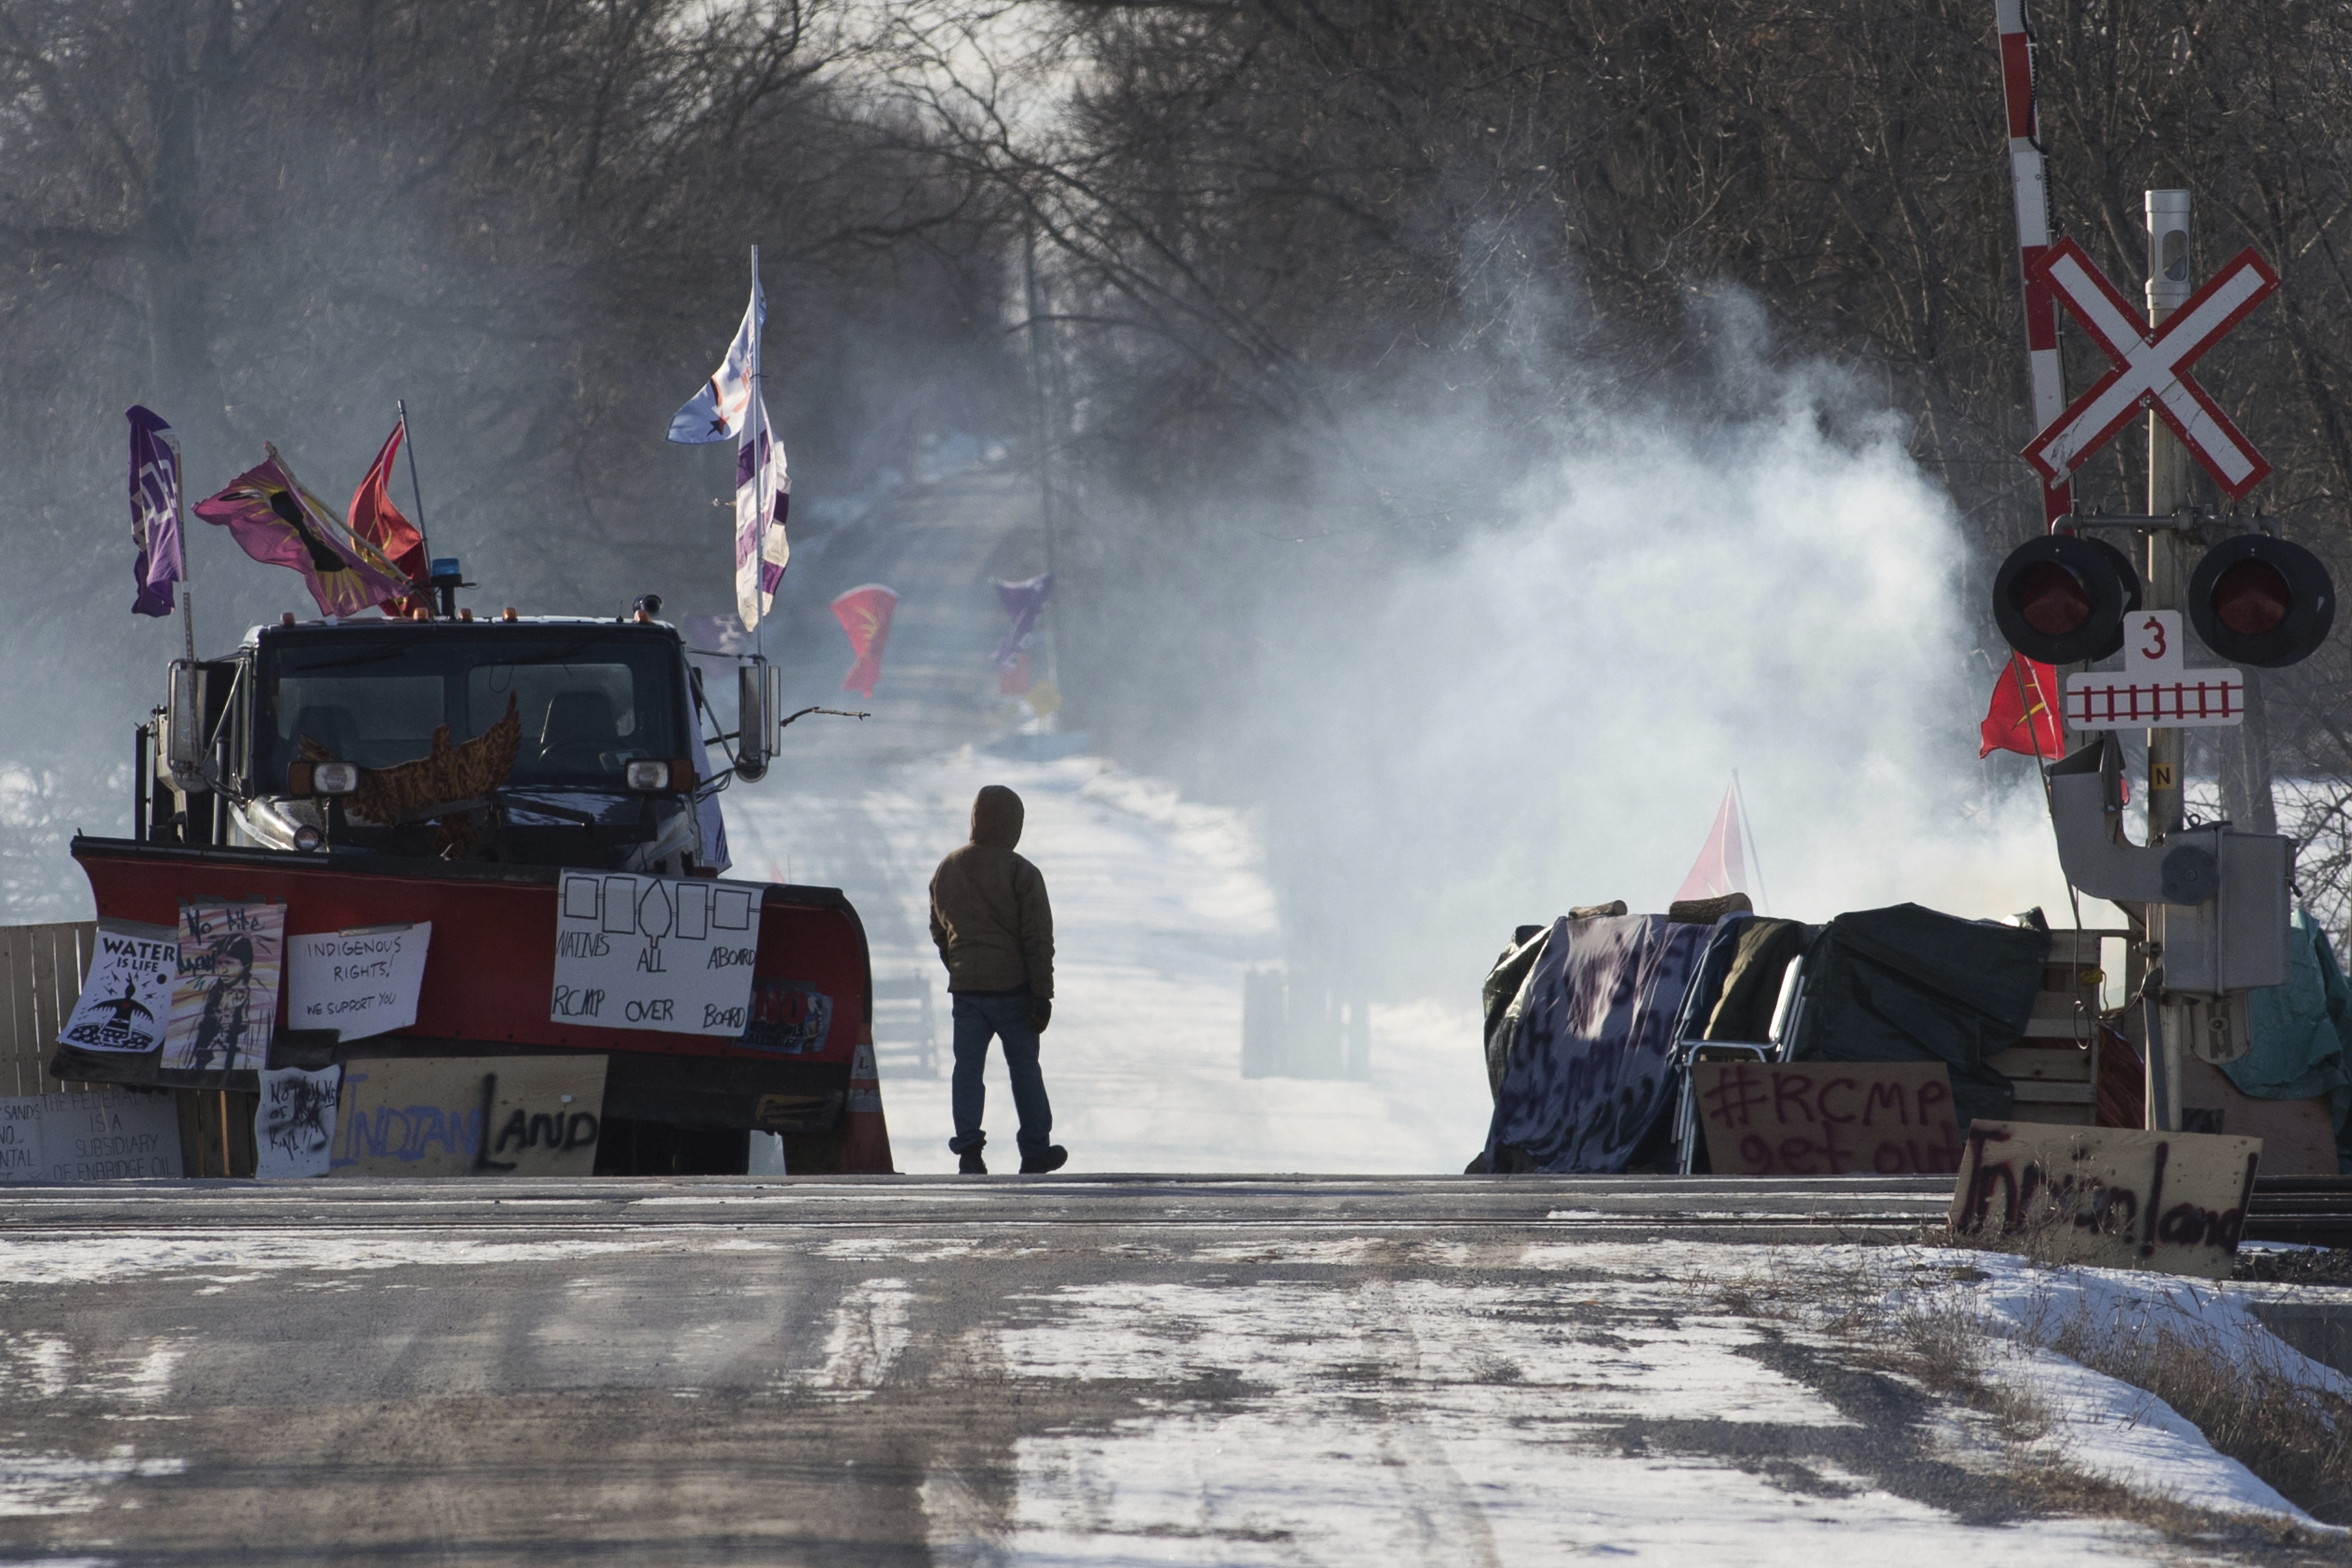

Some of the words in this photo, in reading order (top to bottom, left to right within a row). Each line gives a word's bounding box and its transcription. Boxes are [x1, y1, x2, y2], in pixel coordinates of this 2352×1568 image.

[2141, 619, 2167, 660] 3
[2156, 766, 2171, 785] N
[103, 936, 176, 962] WATER
[308, 936, 401, 958] INDIGENOUS
[557, 930, 610, 958] NATIVES
[637, 947, 667, 972] ALL
[707, 946, 756, 970] ABOARD
[116, 956, 129, 969] IS
[131, 958, 159, 973] LIFE
[334, 954, 394, 981] RIGHTS!
[307, 1001, 322, 1016] WE
[327, 996, 375, 1016] SUPPORT
[378, 992, 396, 1006] YOU
[552, 985, 605, 1017] RCMP
[625, 999, 673, 1022] OVER
[703, 1003, 746, 1029] BOARD
[39, 1093, 67, 1112] THE
[71, 1089, 143, 1111] FEDERAL
[270, 1080, 289, 1104] NO
[1703, 1064, 1952, 1129] #RCMP
[5, 1104, 41, 1121] SANDS
[90, 1116, 106, 1133] IS
[113, 1113, 123, 1132] A
[331, 1074, 481, 1168] INDIAN
[475, 1073, 600, 1171] LAND
[75, 1133, 159, 1159] SUBSIDIARY
[53, 1164, 71, 1180] OF
[77, 1157, 145, 1180] ENBRIDGE
[151, 1156, 176, 1177] OIL
